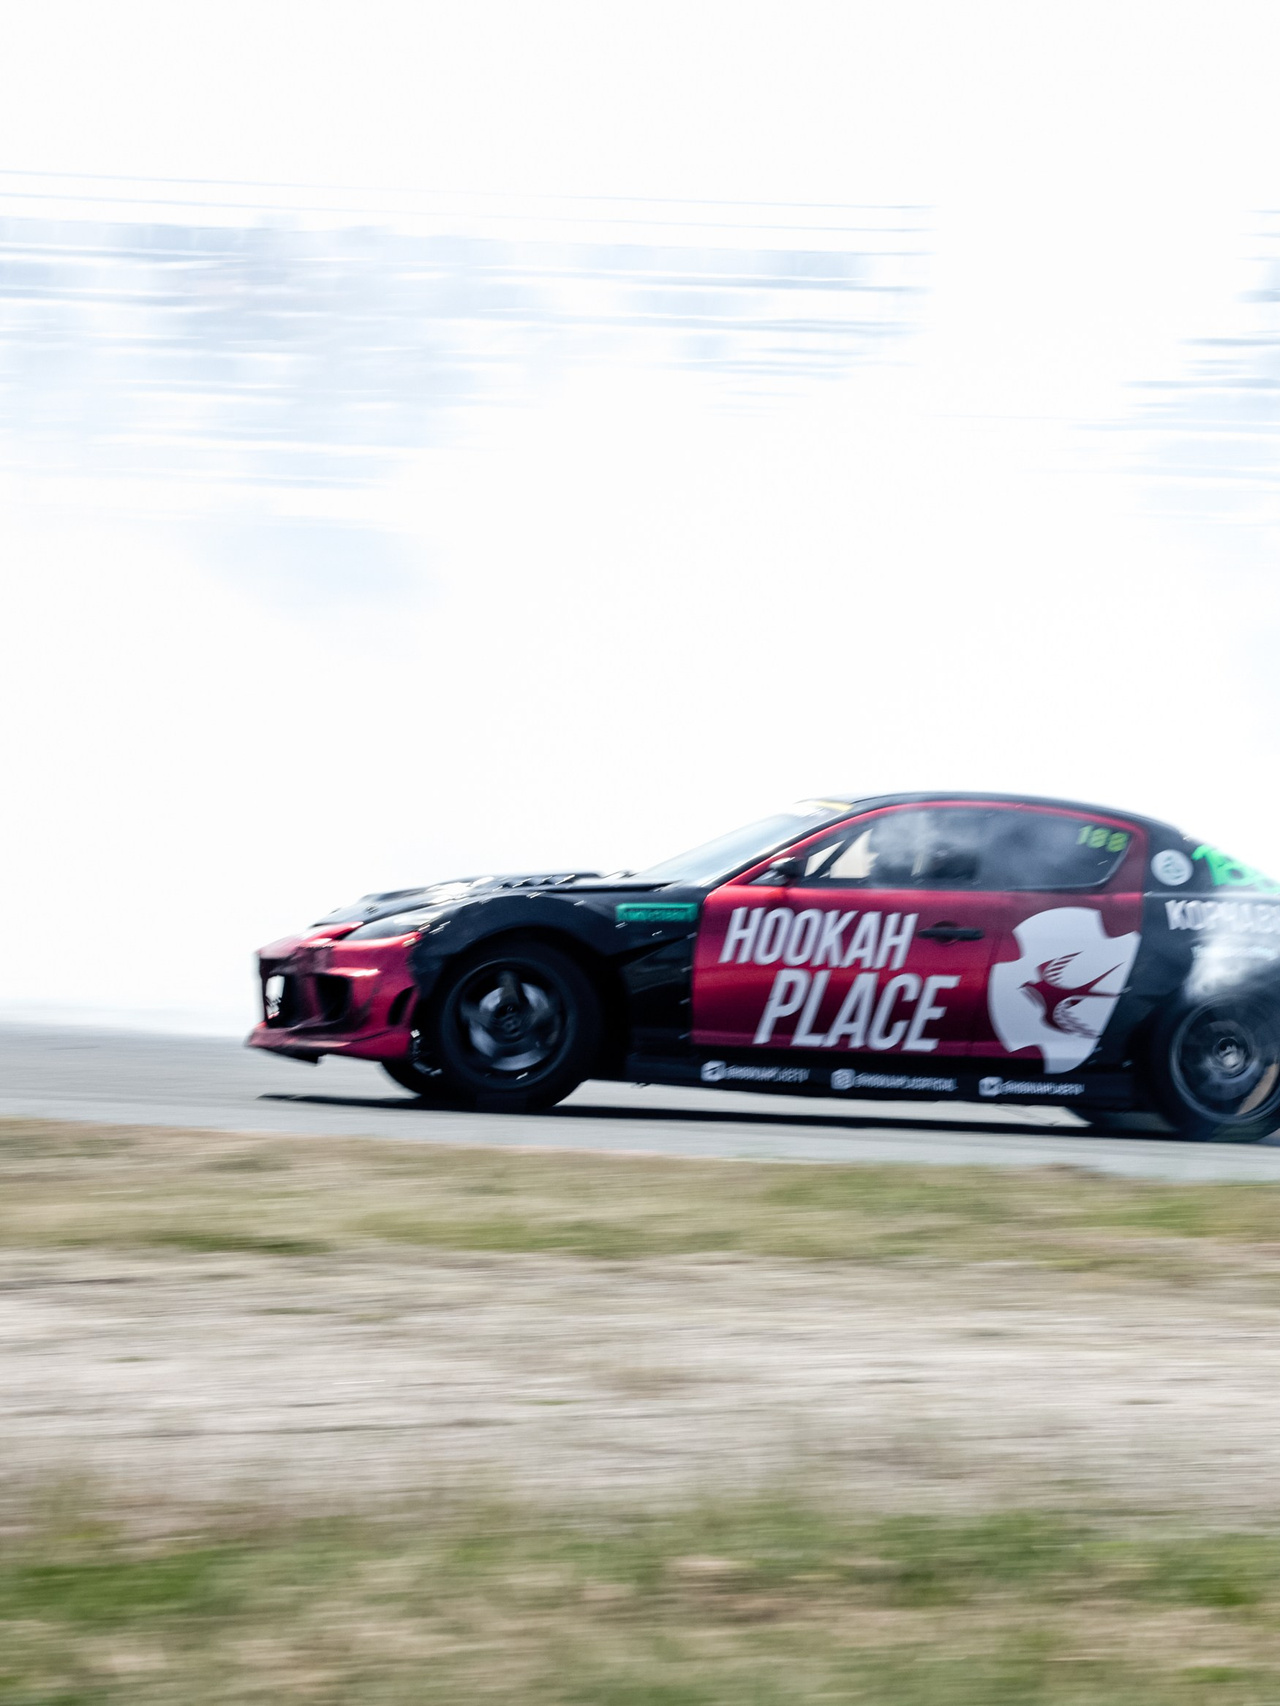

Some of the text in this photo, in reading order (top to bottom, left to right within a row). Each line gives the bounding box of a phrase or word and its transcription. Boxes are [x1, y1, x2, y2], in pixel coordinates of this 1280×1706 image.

[1075, 824, 1130, 853] 188
[718, 905, 920, 971] HOOKAH
[752, 968, 962, 1053] PLACE
